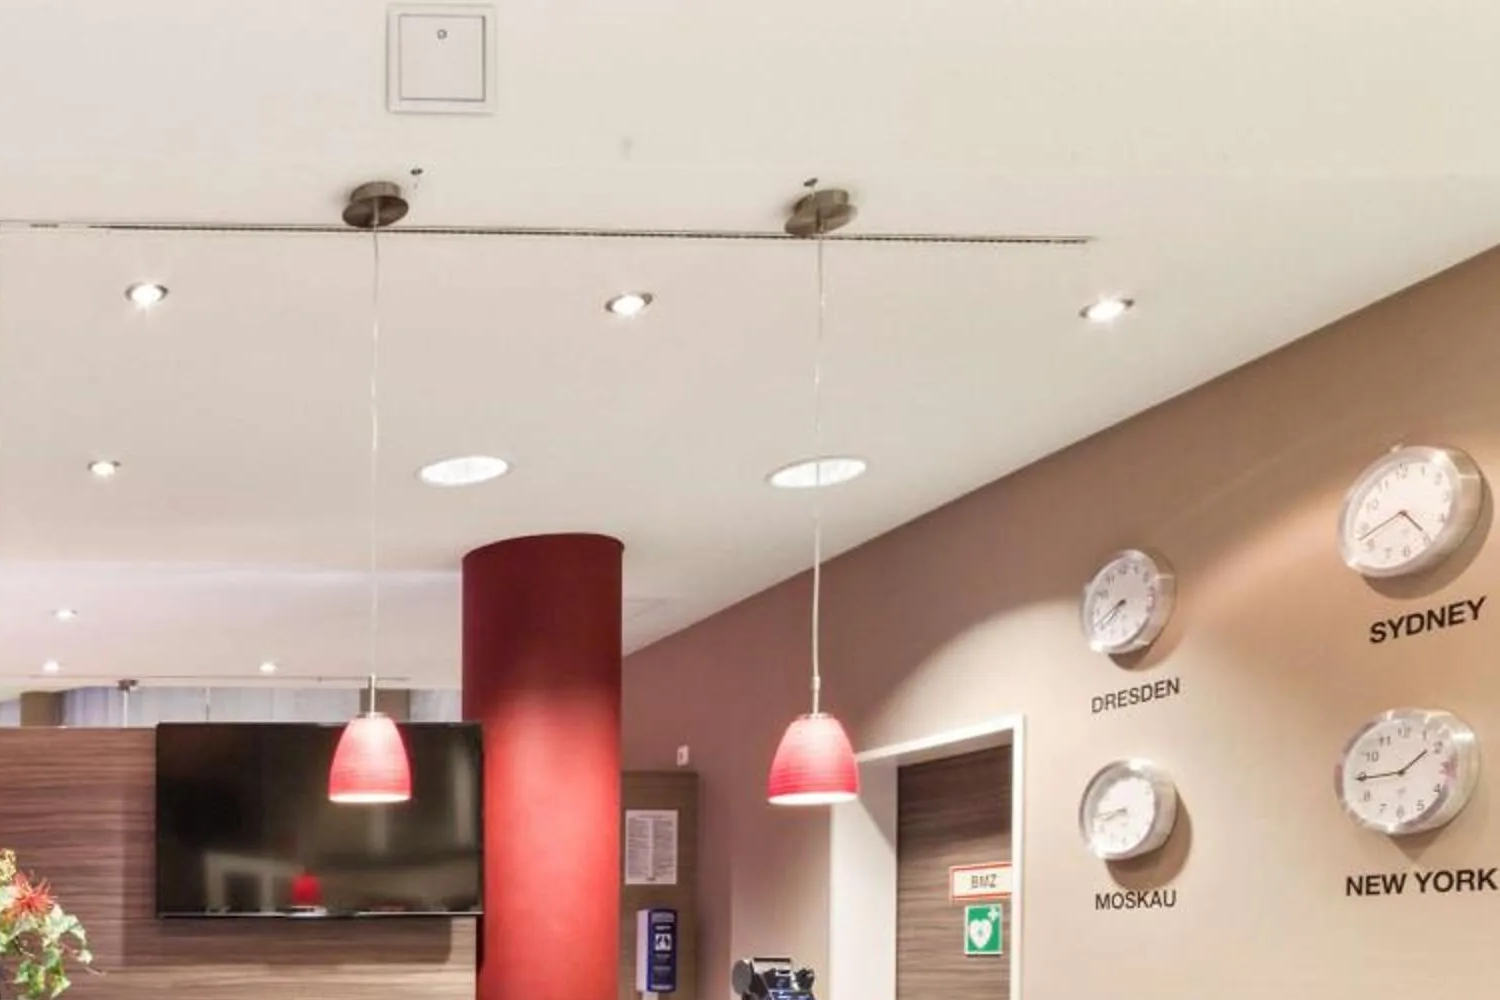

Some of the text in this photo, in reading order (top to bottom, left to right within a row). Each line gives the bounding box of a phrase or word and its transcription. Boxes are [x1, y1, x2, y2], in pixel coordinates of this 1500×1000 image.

[1369, 596, 1486, 644] SYDNEY
[1091, 677, 1180, 713] DRESDEN
[971, 873, 997, 889] BMZ
[1345, 867, 1499, 897] NEW YORK
[1095, 890, 1177, 910] MOSKAU
